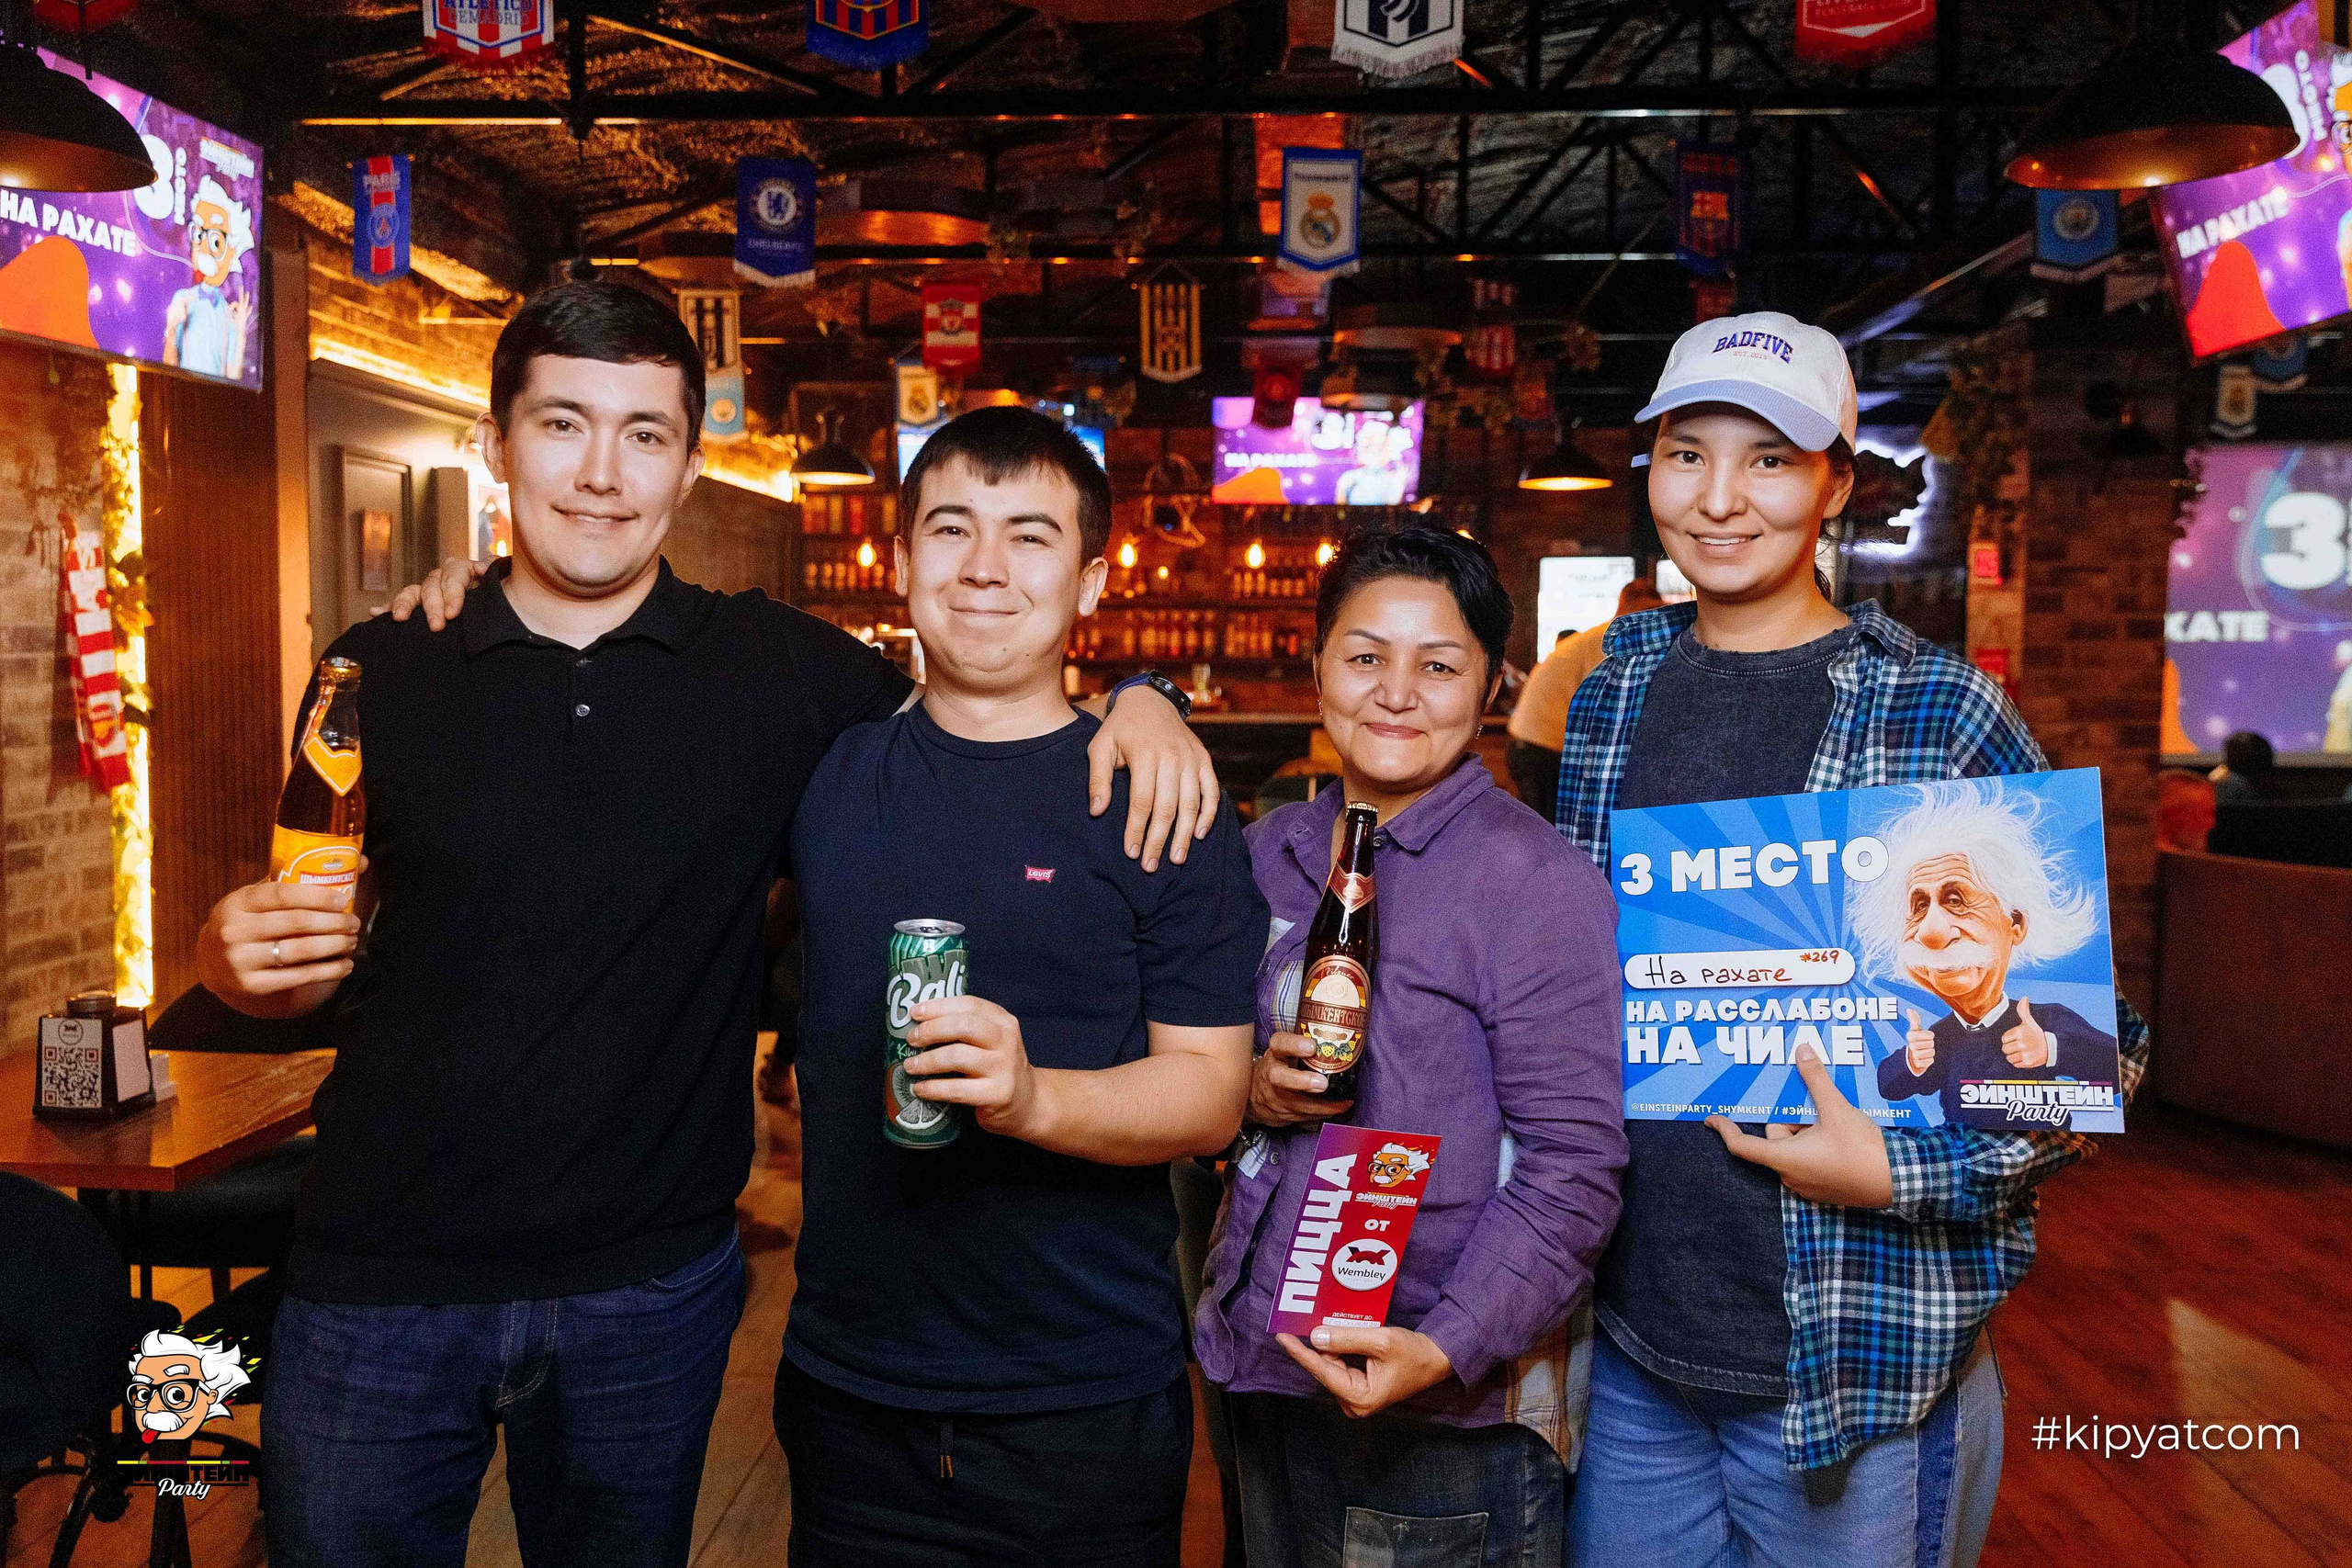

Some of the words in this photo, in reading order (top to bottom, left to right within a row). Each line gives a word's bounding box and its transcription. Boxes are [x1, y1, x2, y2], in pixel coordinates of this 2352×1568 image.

[42, 202, 138, 258] РАХАТЕ
[1712, 331, 1794, 365] BADFIVE
[2261, 491, 2346, 591] 3
[1620, 852, 1654, 897] 3
[1670, 835, 1890, 893] МЕСТО
[1645, 955, 1687, 986] На
[1702, 967, 1792, 984] рахате
[1800, 950, 1840, 964] #269
[1626, 999, 1668, 1022] НА
[1675, 997, 1899, 1021] РАССЛАБОНЕ
[1626, 1026, 1702, 1066] НА
[1716, 1025, 1865, 1066] ЧИЛЕ
[1631, 1102, 1771, 1115] @EINSTEINPARTY_SHYMKENT
[2007, 1100, 2070, 1127] Party
[1278, 1154, 1358, 1314] ПИЦЦА
[1364, 1219, 1391, 1232] ОТ
[1338, 1267, 1386, 1281] Wembley
[1332, 1312, 1364, 1320] ДЕЙСТВУЕТ
